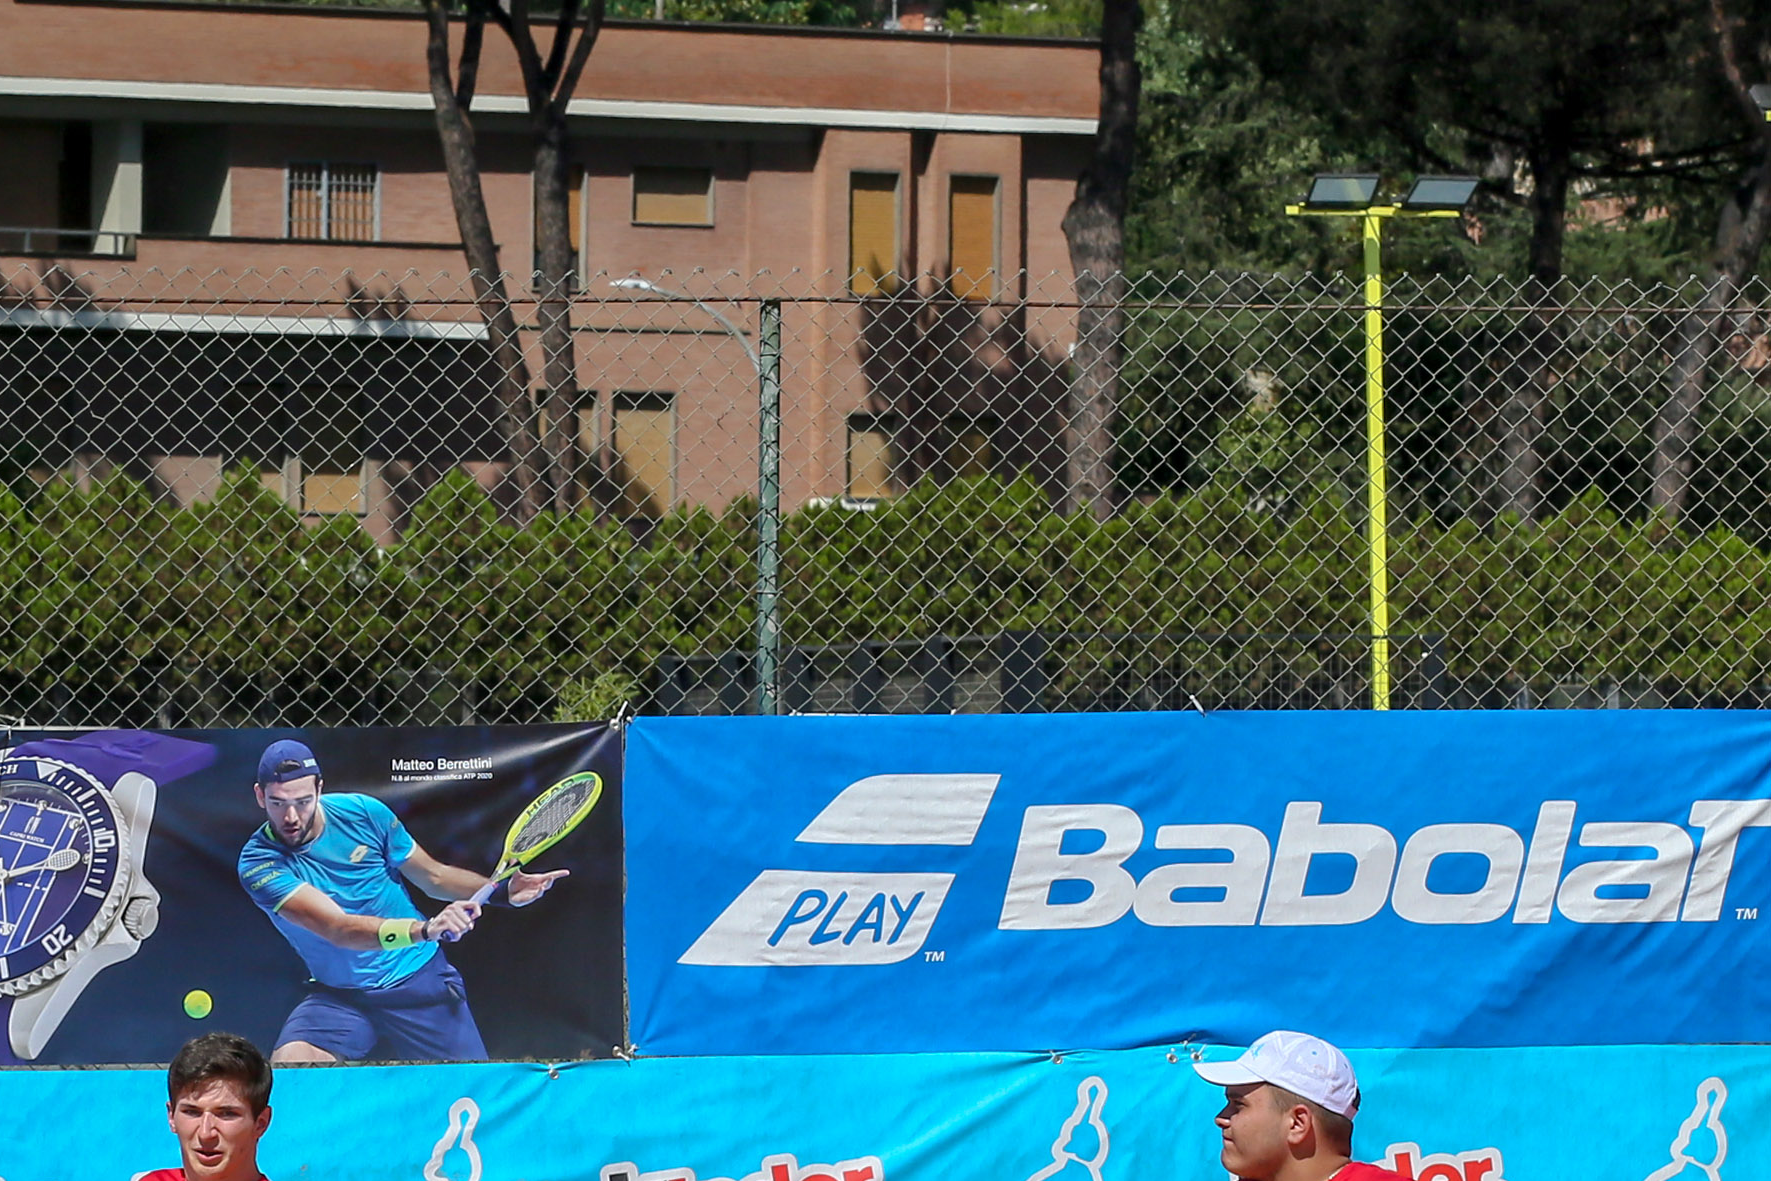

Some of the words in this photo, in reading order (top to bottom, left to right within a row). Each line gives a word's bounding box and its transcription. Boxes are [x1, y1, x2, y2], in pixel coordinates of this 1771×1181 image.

[391, 758, 434, 772] Matteo
[437, 757, 493, 771] Berrettini
[411, 773, 433, 782] mondo
[767, 888, 925, 948] PLAY
